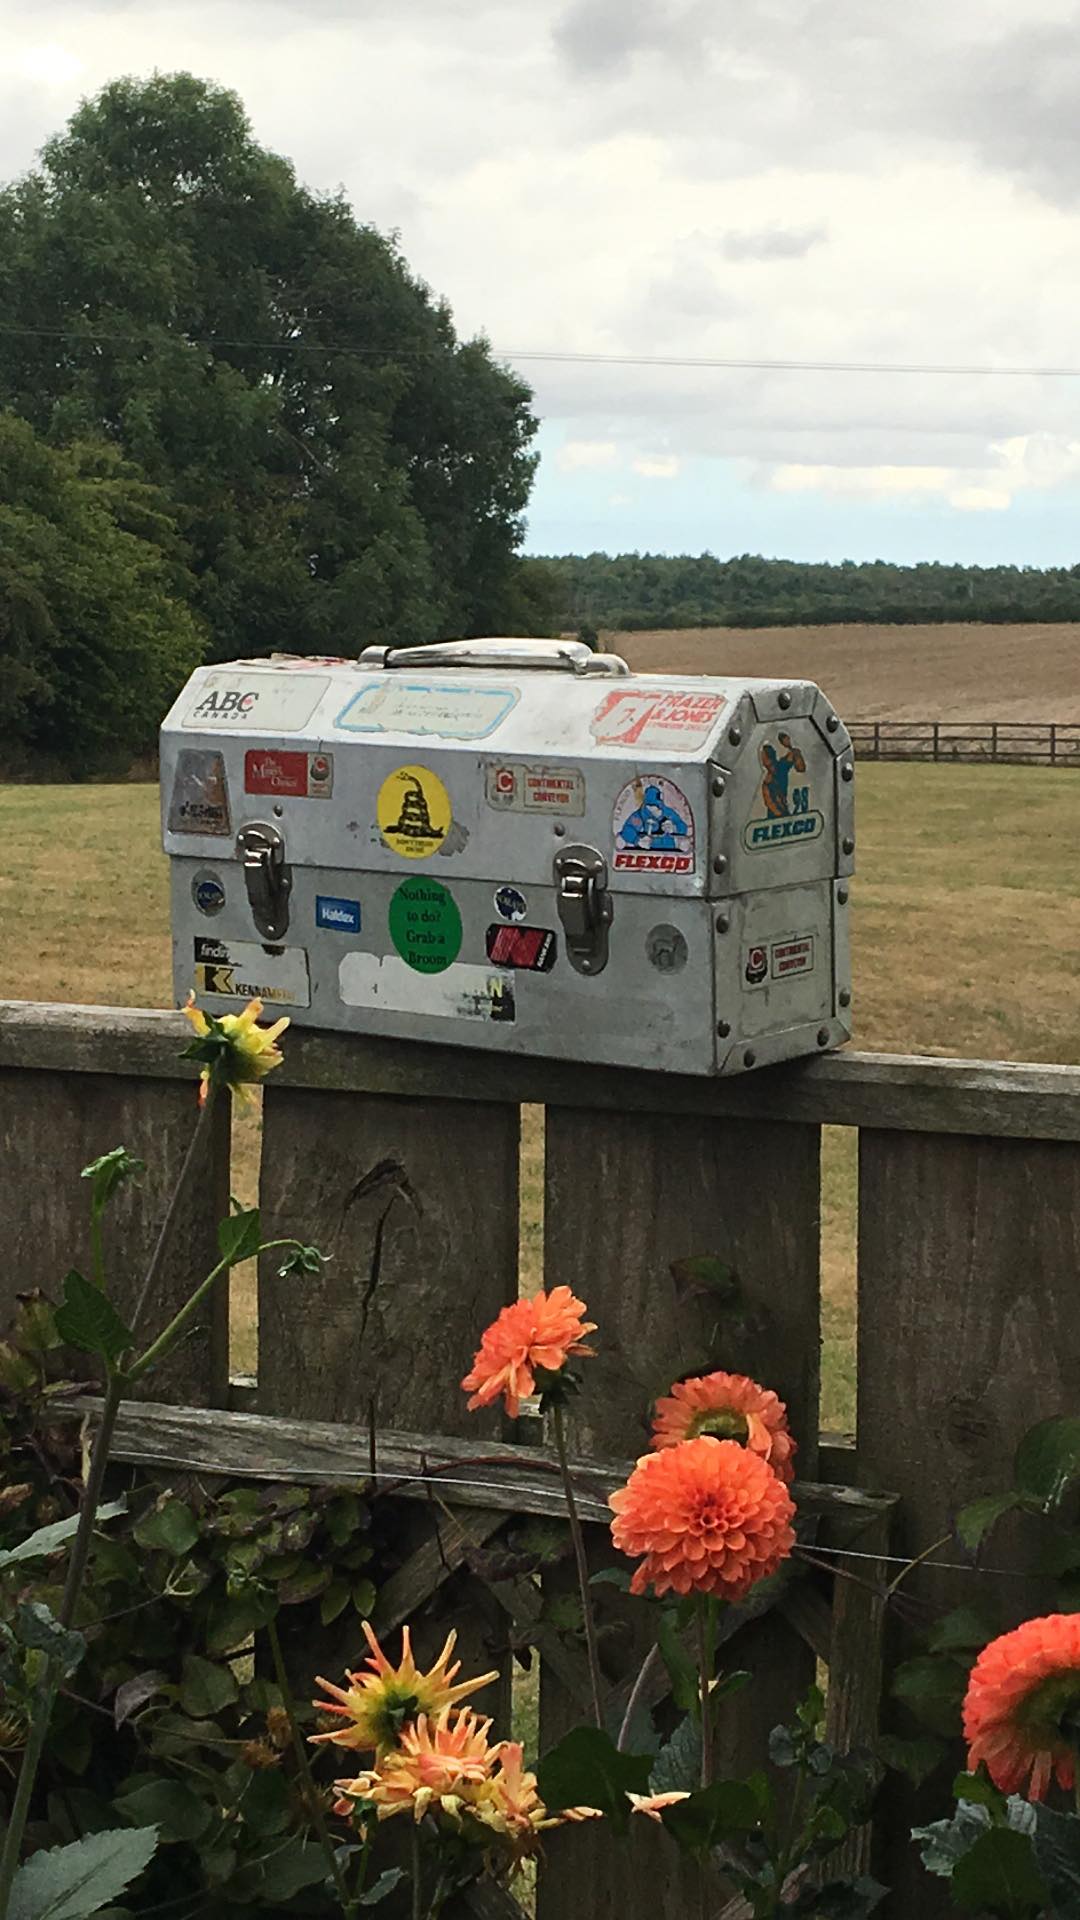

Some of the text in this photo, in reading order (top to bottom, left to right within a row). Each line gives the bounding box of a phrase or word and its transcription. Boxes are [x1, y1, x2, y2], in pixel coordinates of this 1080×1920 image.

[195, 691, 259, 712] ABC
[659, 693, 723, 709] FRAZER
[193, 711, 248, 719] CANADA
[664, 711, 717, 723] JONES
[752, 817, 817, 843] FLEXCO
[615, 854, 692, 871] FLEXCO
[399, 888, 447, 907] Nothing
[321, 907, 355, 923] Haldex
[407, 910, 441, 923] to do?
[406, 930, 446, 945] Grab a
[408, 951, 447, 965] Broom
